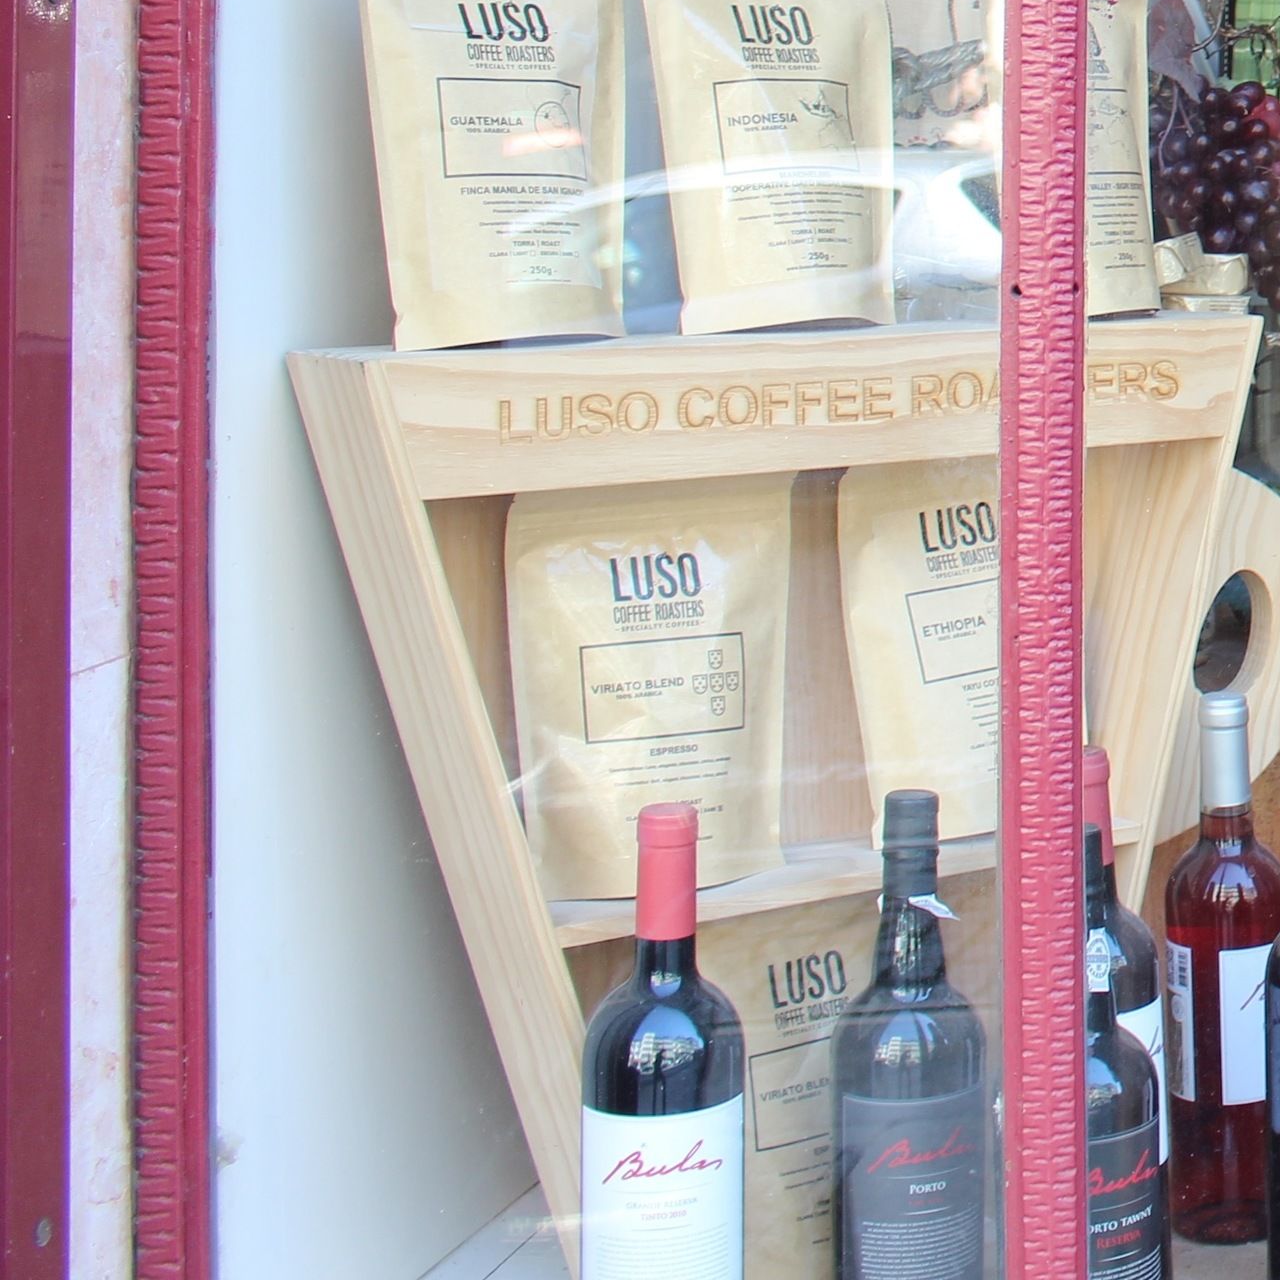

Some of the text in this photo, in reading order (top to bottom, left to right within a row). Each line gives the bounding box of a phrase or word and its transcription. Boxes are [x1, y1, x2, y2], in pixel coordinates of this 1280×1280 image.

[458, 1, 549, 42] LUSO
[731, 4, 814, 45] LUSO
[467, 44, 555, 63] COFFEE ROASTERS
[742, 46, 820, 64] COFFEE ROASTERS
[450, 116, 523, 127] GUATEMALA
[728, 113, 798, 127] INDONESIA
[460, 186, 490, 195] FINCA
[528, 186, 540, 194] DE
[529, 266, 552, 276] 250g
[497, 360, 1181, 446] LUSO COFFEE ROERS
[919, 501, 997, 553] LUSO
[926, 545, 999, 573] COFFEE ROASTER
[609, 552, 702, 603] LUSO
[613, 600, 704, 625] COFFEE ROASTERS
[922, 615, 986, 638] ETHIOPIA
[591, 676, 685, 695] VIRIATO BLEND
[650, 743, 699, 757] ESPRESSO
[768, 950, 847, 1009] LUSO
[774, 1007, 805, 1030] COFFEE
[760, 1077, 831, 1103] VIRIATO BLEN
[909, 1180, 947, 1195] PORTO
[1089, 1204, 1153, 1235] ORTO TAWNY
[1097, 1229, 1142, 1249] RESERVA
